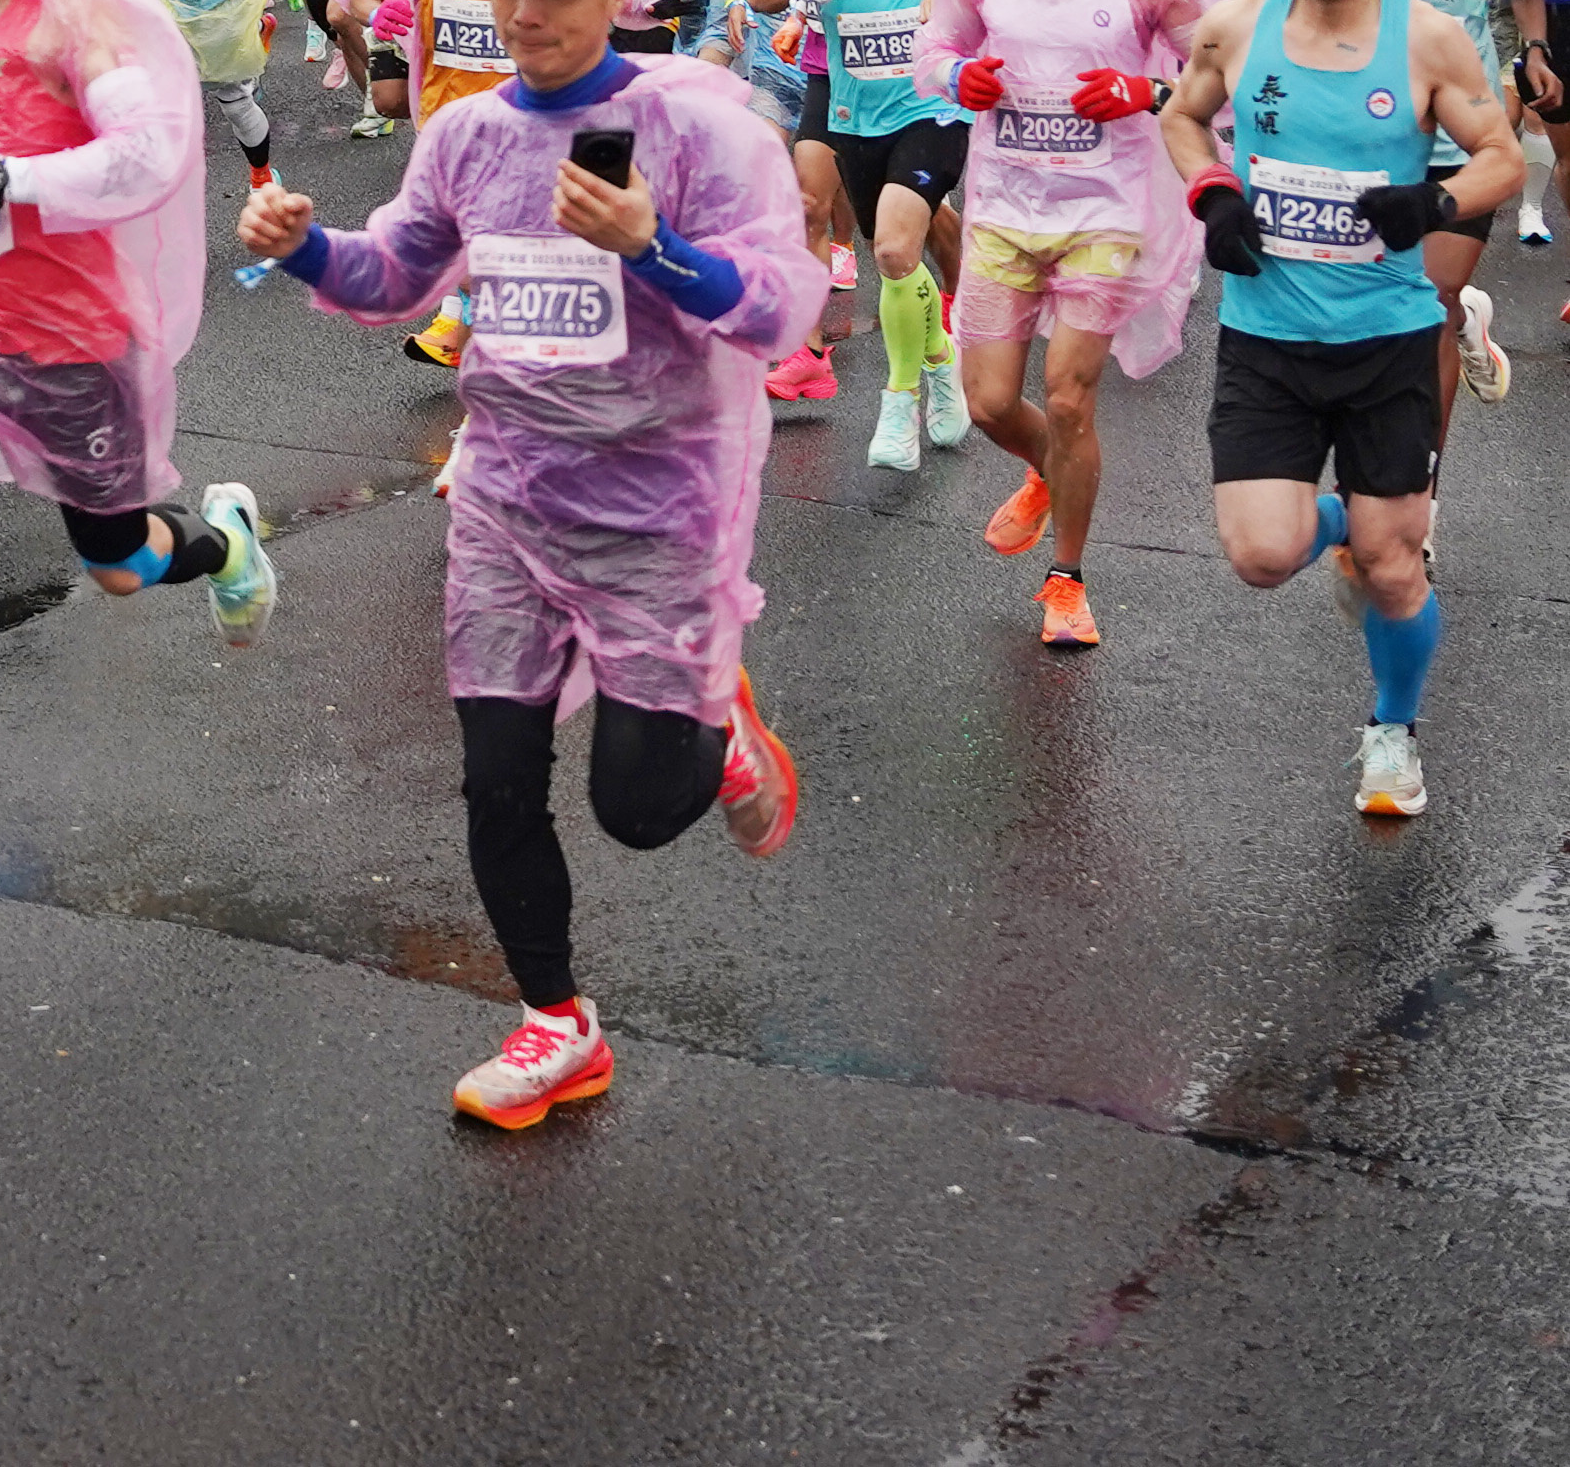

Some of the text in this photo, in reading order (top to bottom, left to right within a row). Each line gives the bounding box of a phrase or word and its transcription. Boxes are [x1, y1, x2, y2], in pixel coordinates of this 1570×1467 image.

[436, 22, 505, 49] A 221
[843, 34, 913, 62] A 2189
[998, 113, 1097, 142] A 20922
[1253, 192, 1275, 227] A
[476, 281, 603, 323] A 20775
